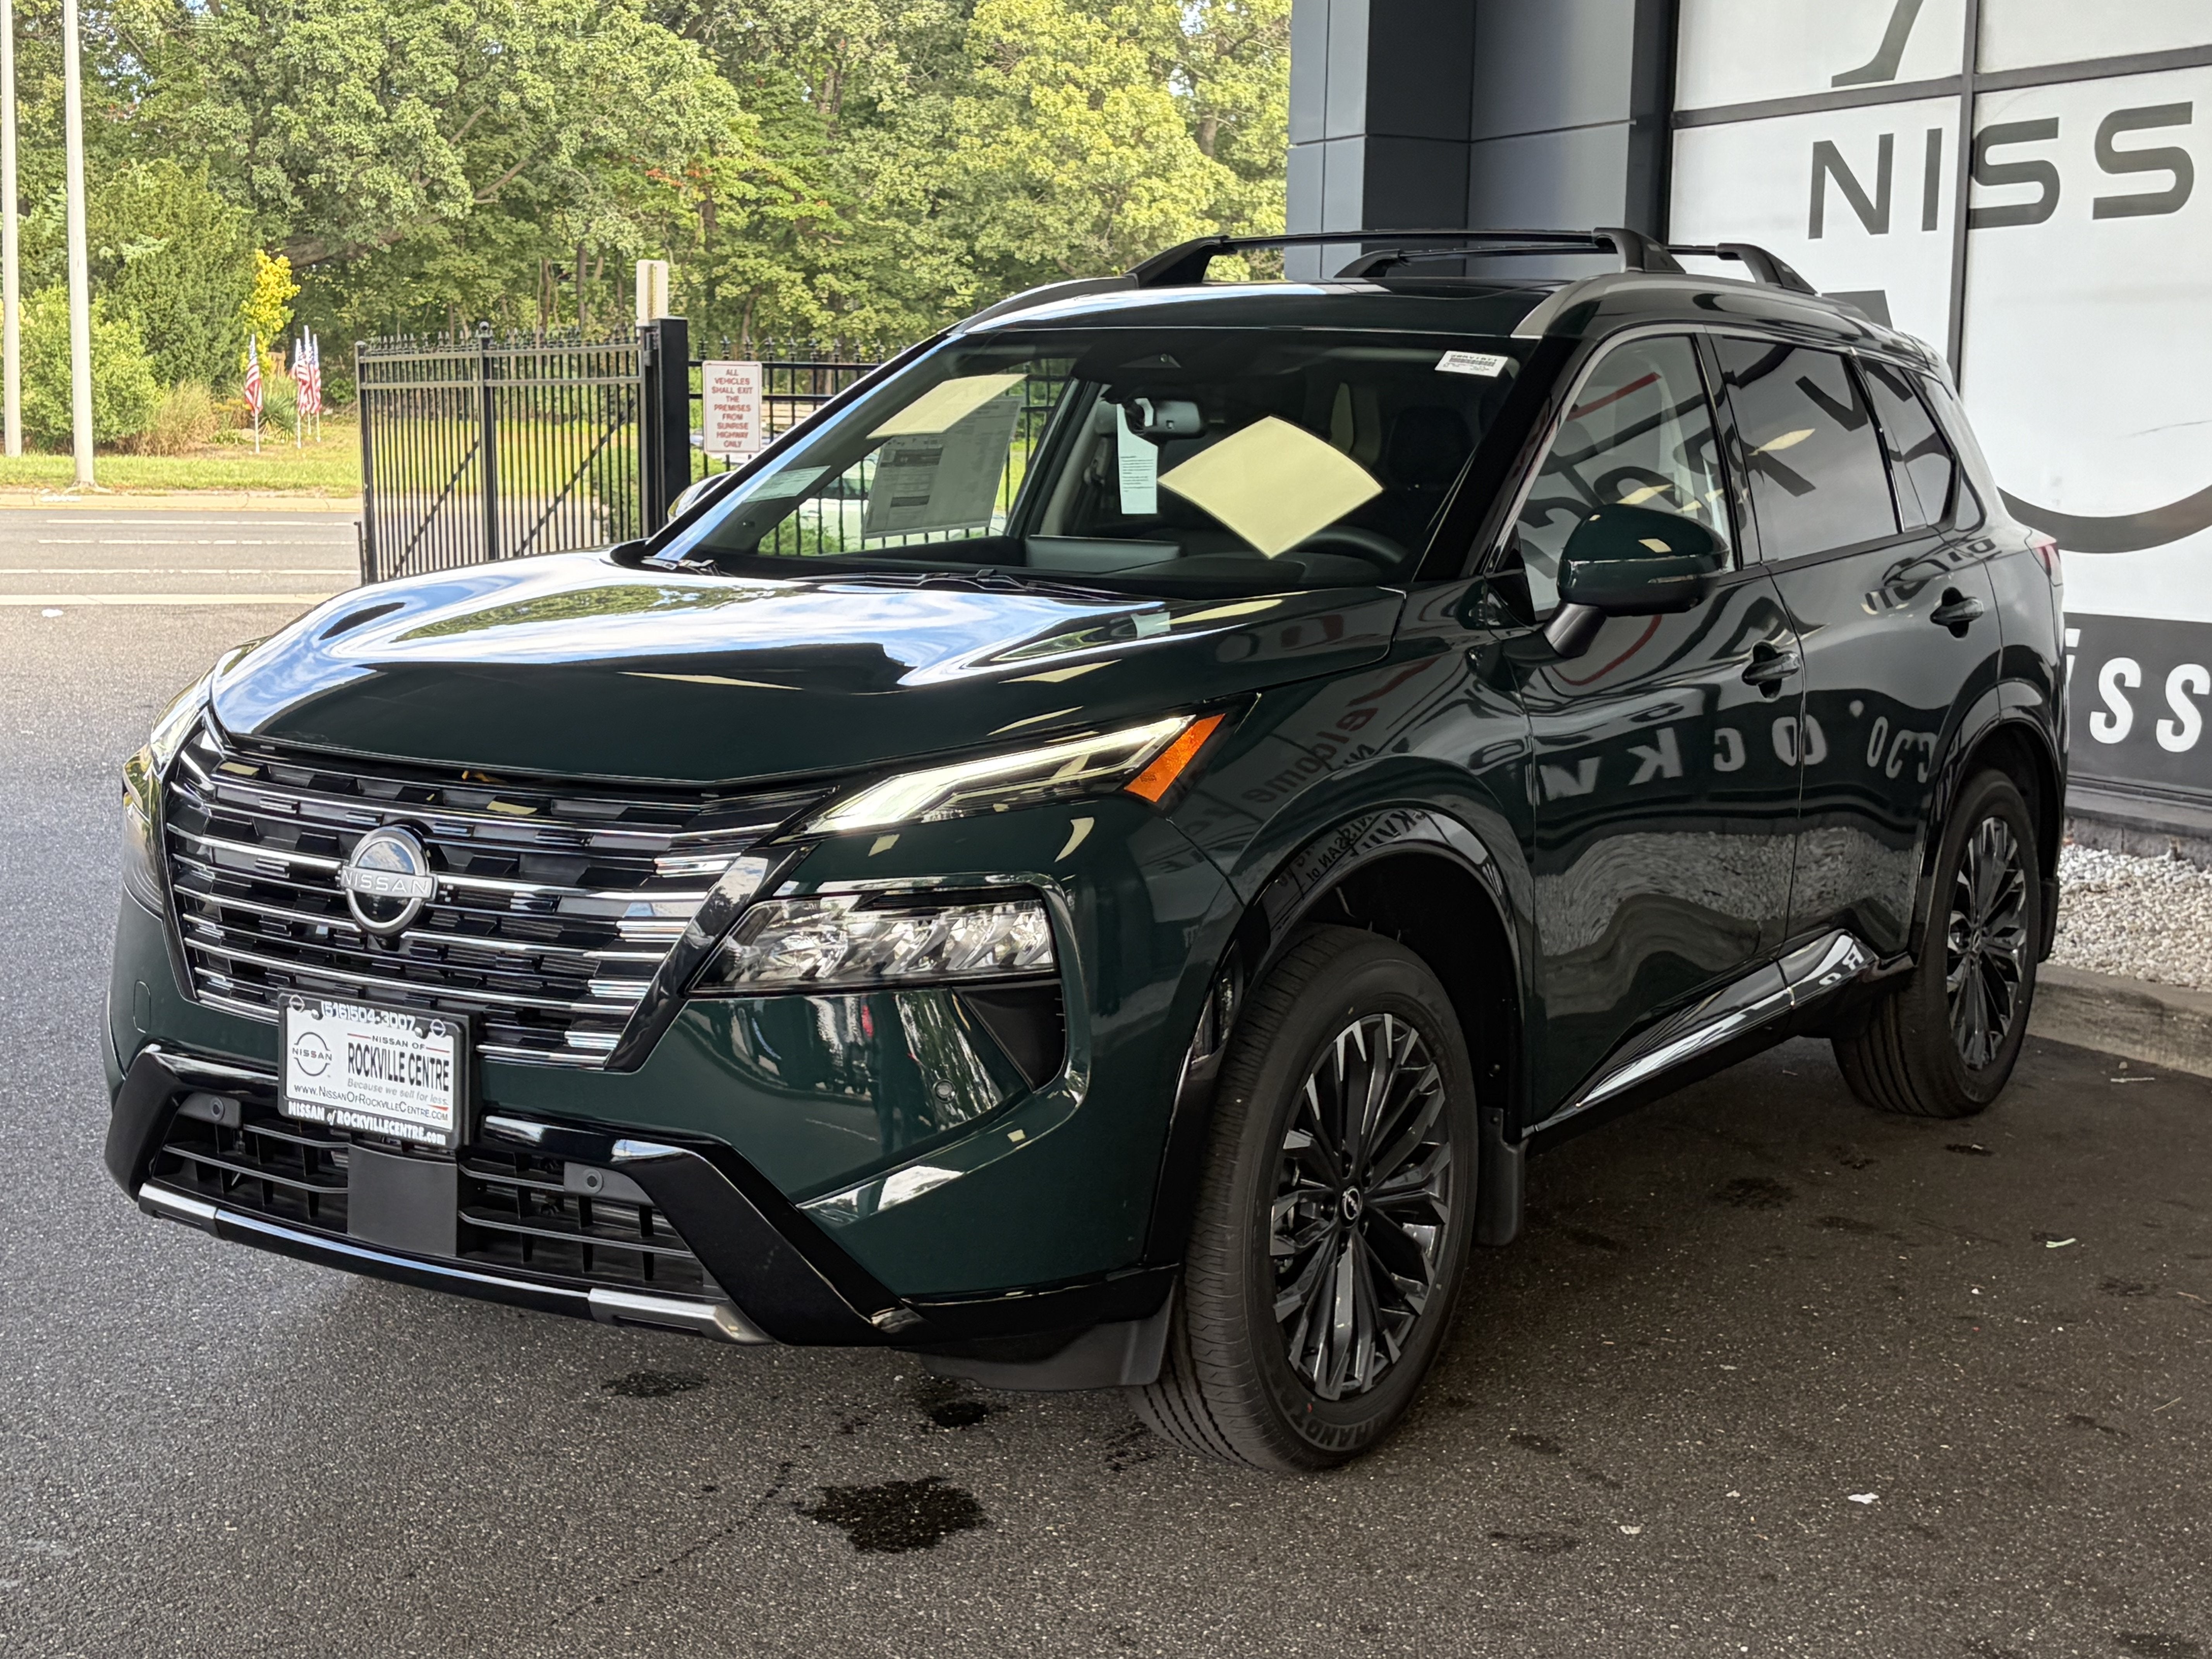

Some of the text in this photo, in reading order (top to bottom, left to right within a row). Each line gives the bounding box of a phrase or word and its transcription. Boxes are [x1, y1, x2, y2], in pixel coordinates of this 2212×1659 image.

[1808, 101, 2195, 239] NISS
[714, 404, 751, 412] PREMISES
[342, 869, 428, 894] NISSAN
[321, 1000, 416, 1031] (516)5043007
[372, 1035, 408, 1048] NISSAN
[292, 1048, 332, 1061] NISSAN
[348, 1042, 449, 1092] ROCKVILLE CENTRE
[347, 1077, 383, 1093] Because
[385, 1087, 397, 1096] we
[400, 1089, 414, 1099] sell
[417, 1091, 428, 1101] for
[288, 1101, 325, 1121] NISSAN
[327, 1108, 336, 1126] of
